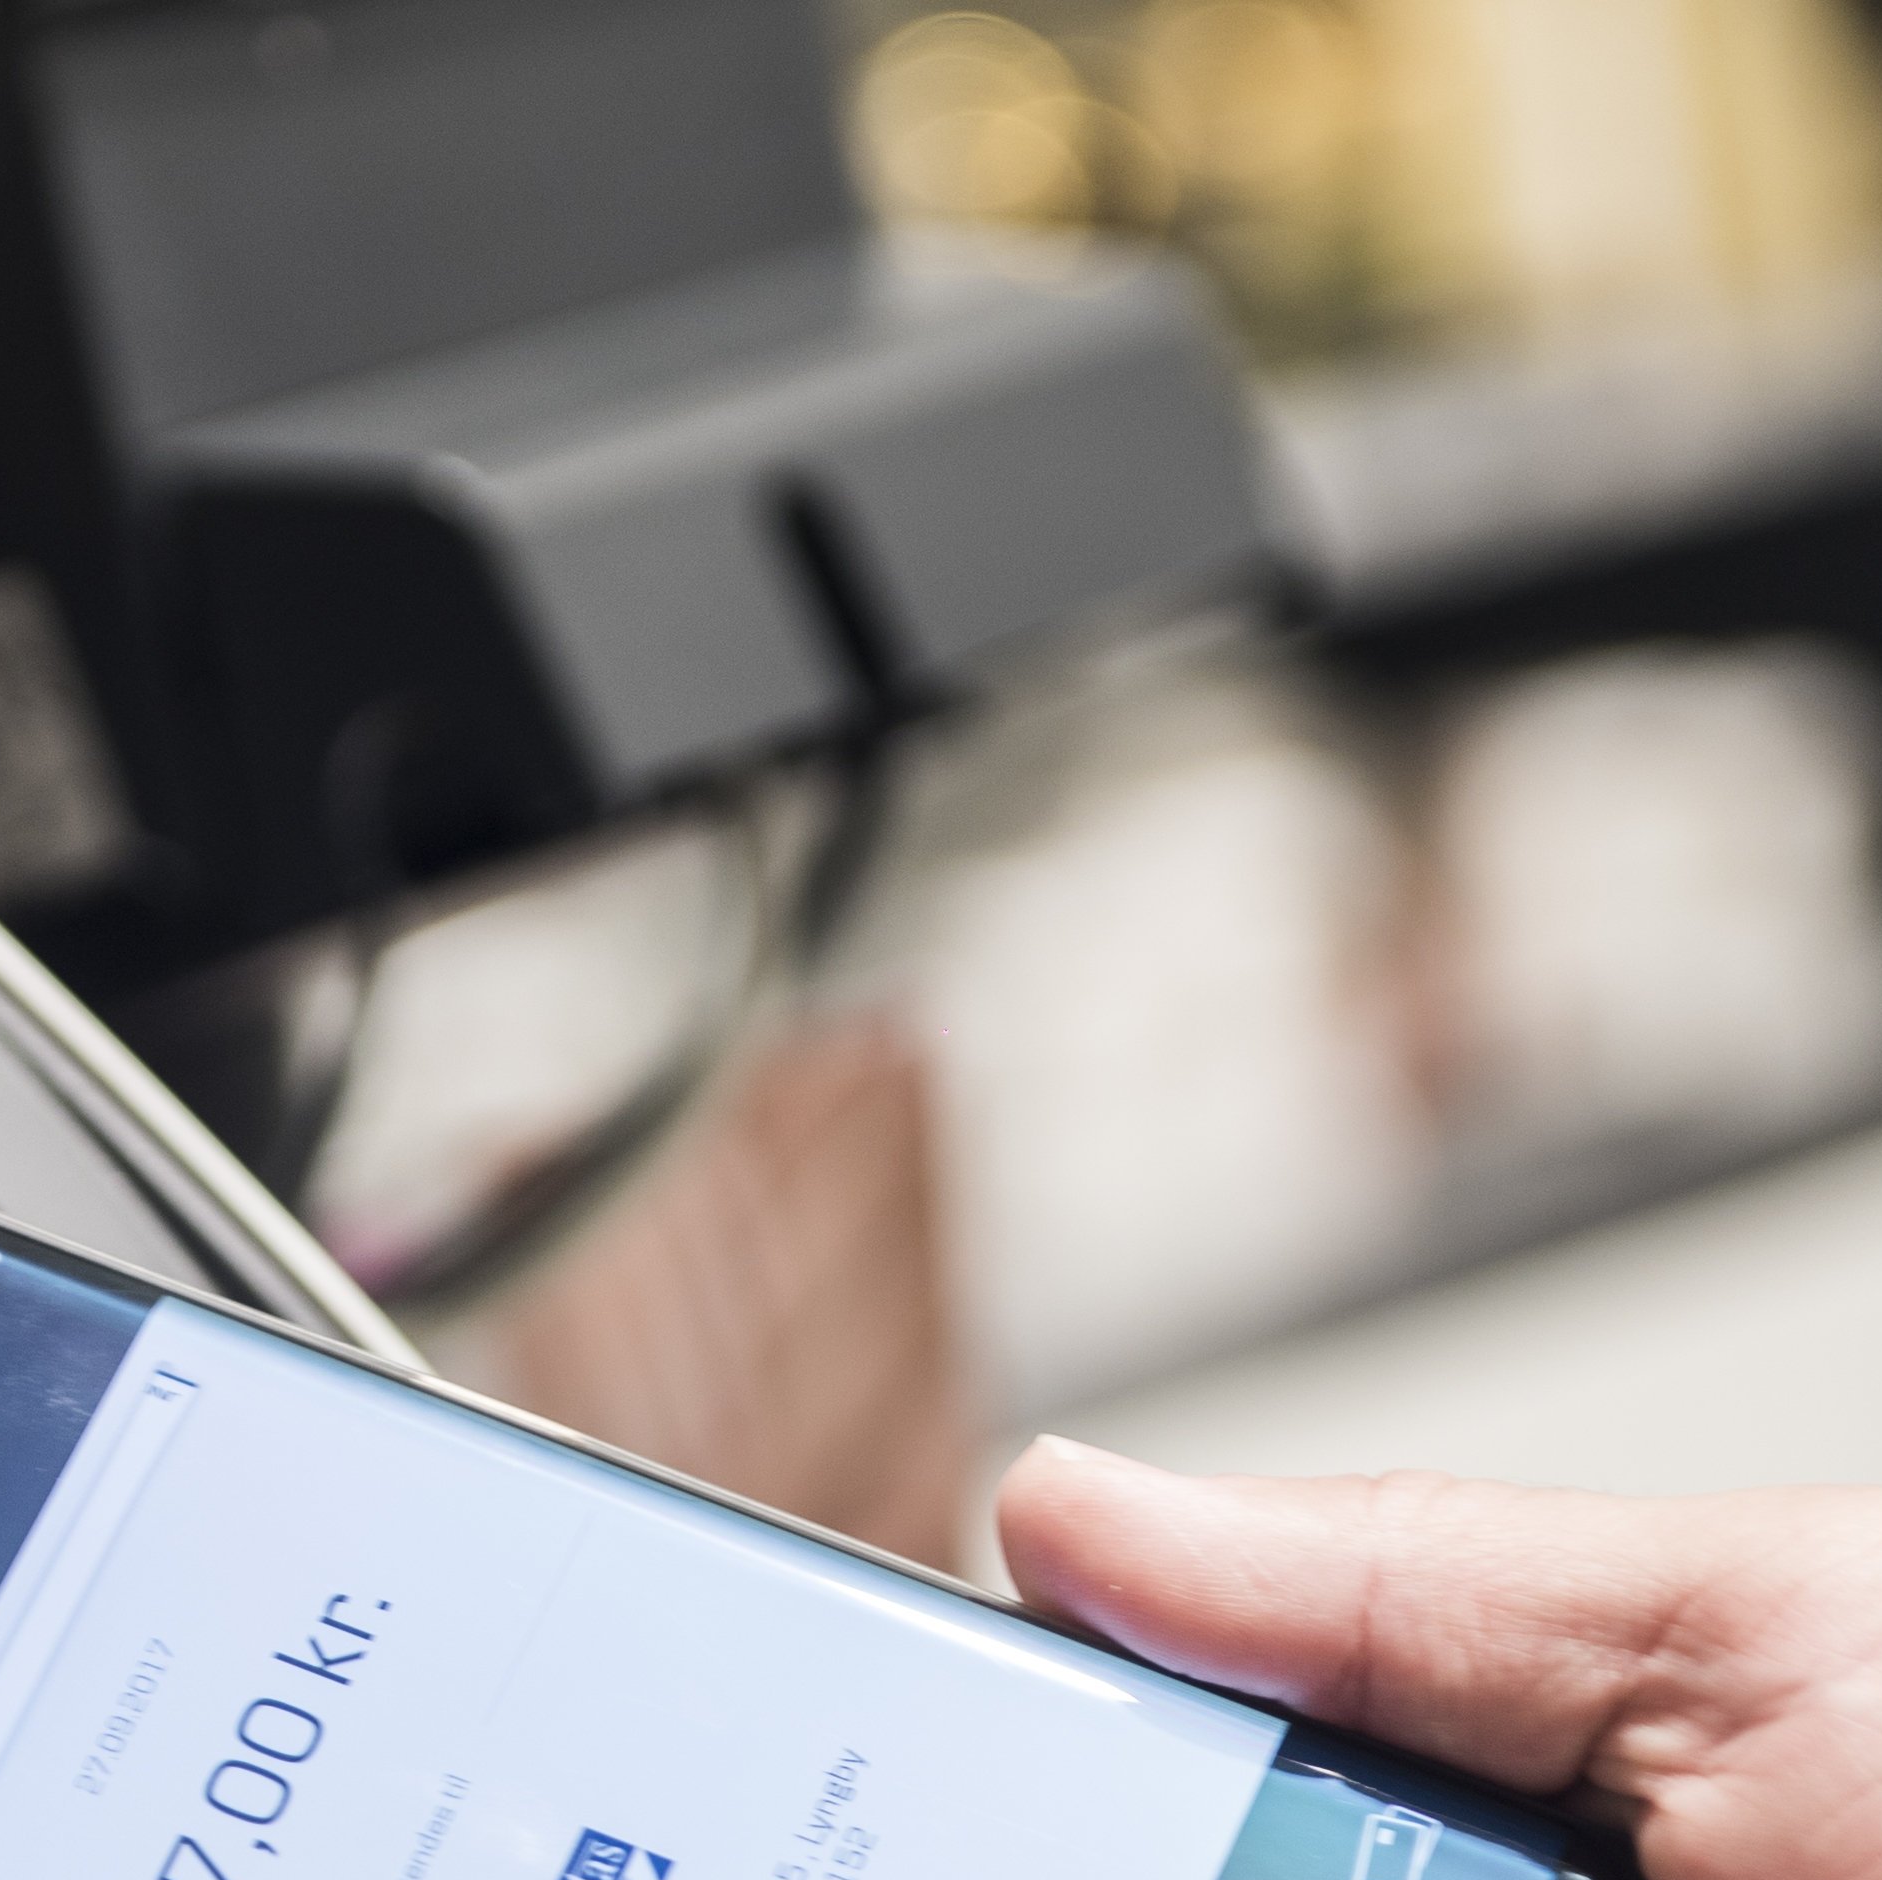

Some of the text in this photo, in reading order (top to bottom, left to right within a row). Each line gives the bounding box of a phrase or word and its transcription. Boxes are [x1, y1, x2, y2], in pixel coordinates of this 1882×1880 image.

[272, 1592, 393, 1687] kr.
[71, 1636, 174, 1798] 27.09.2017
[792, 1747, 871, 1848] Lyngby
